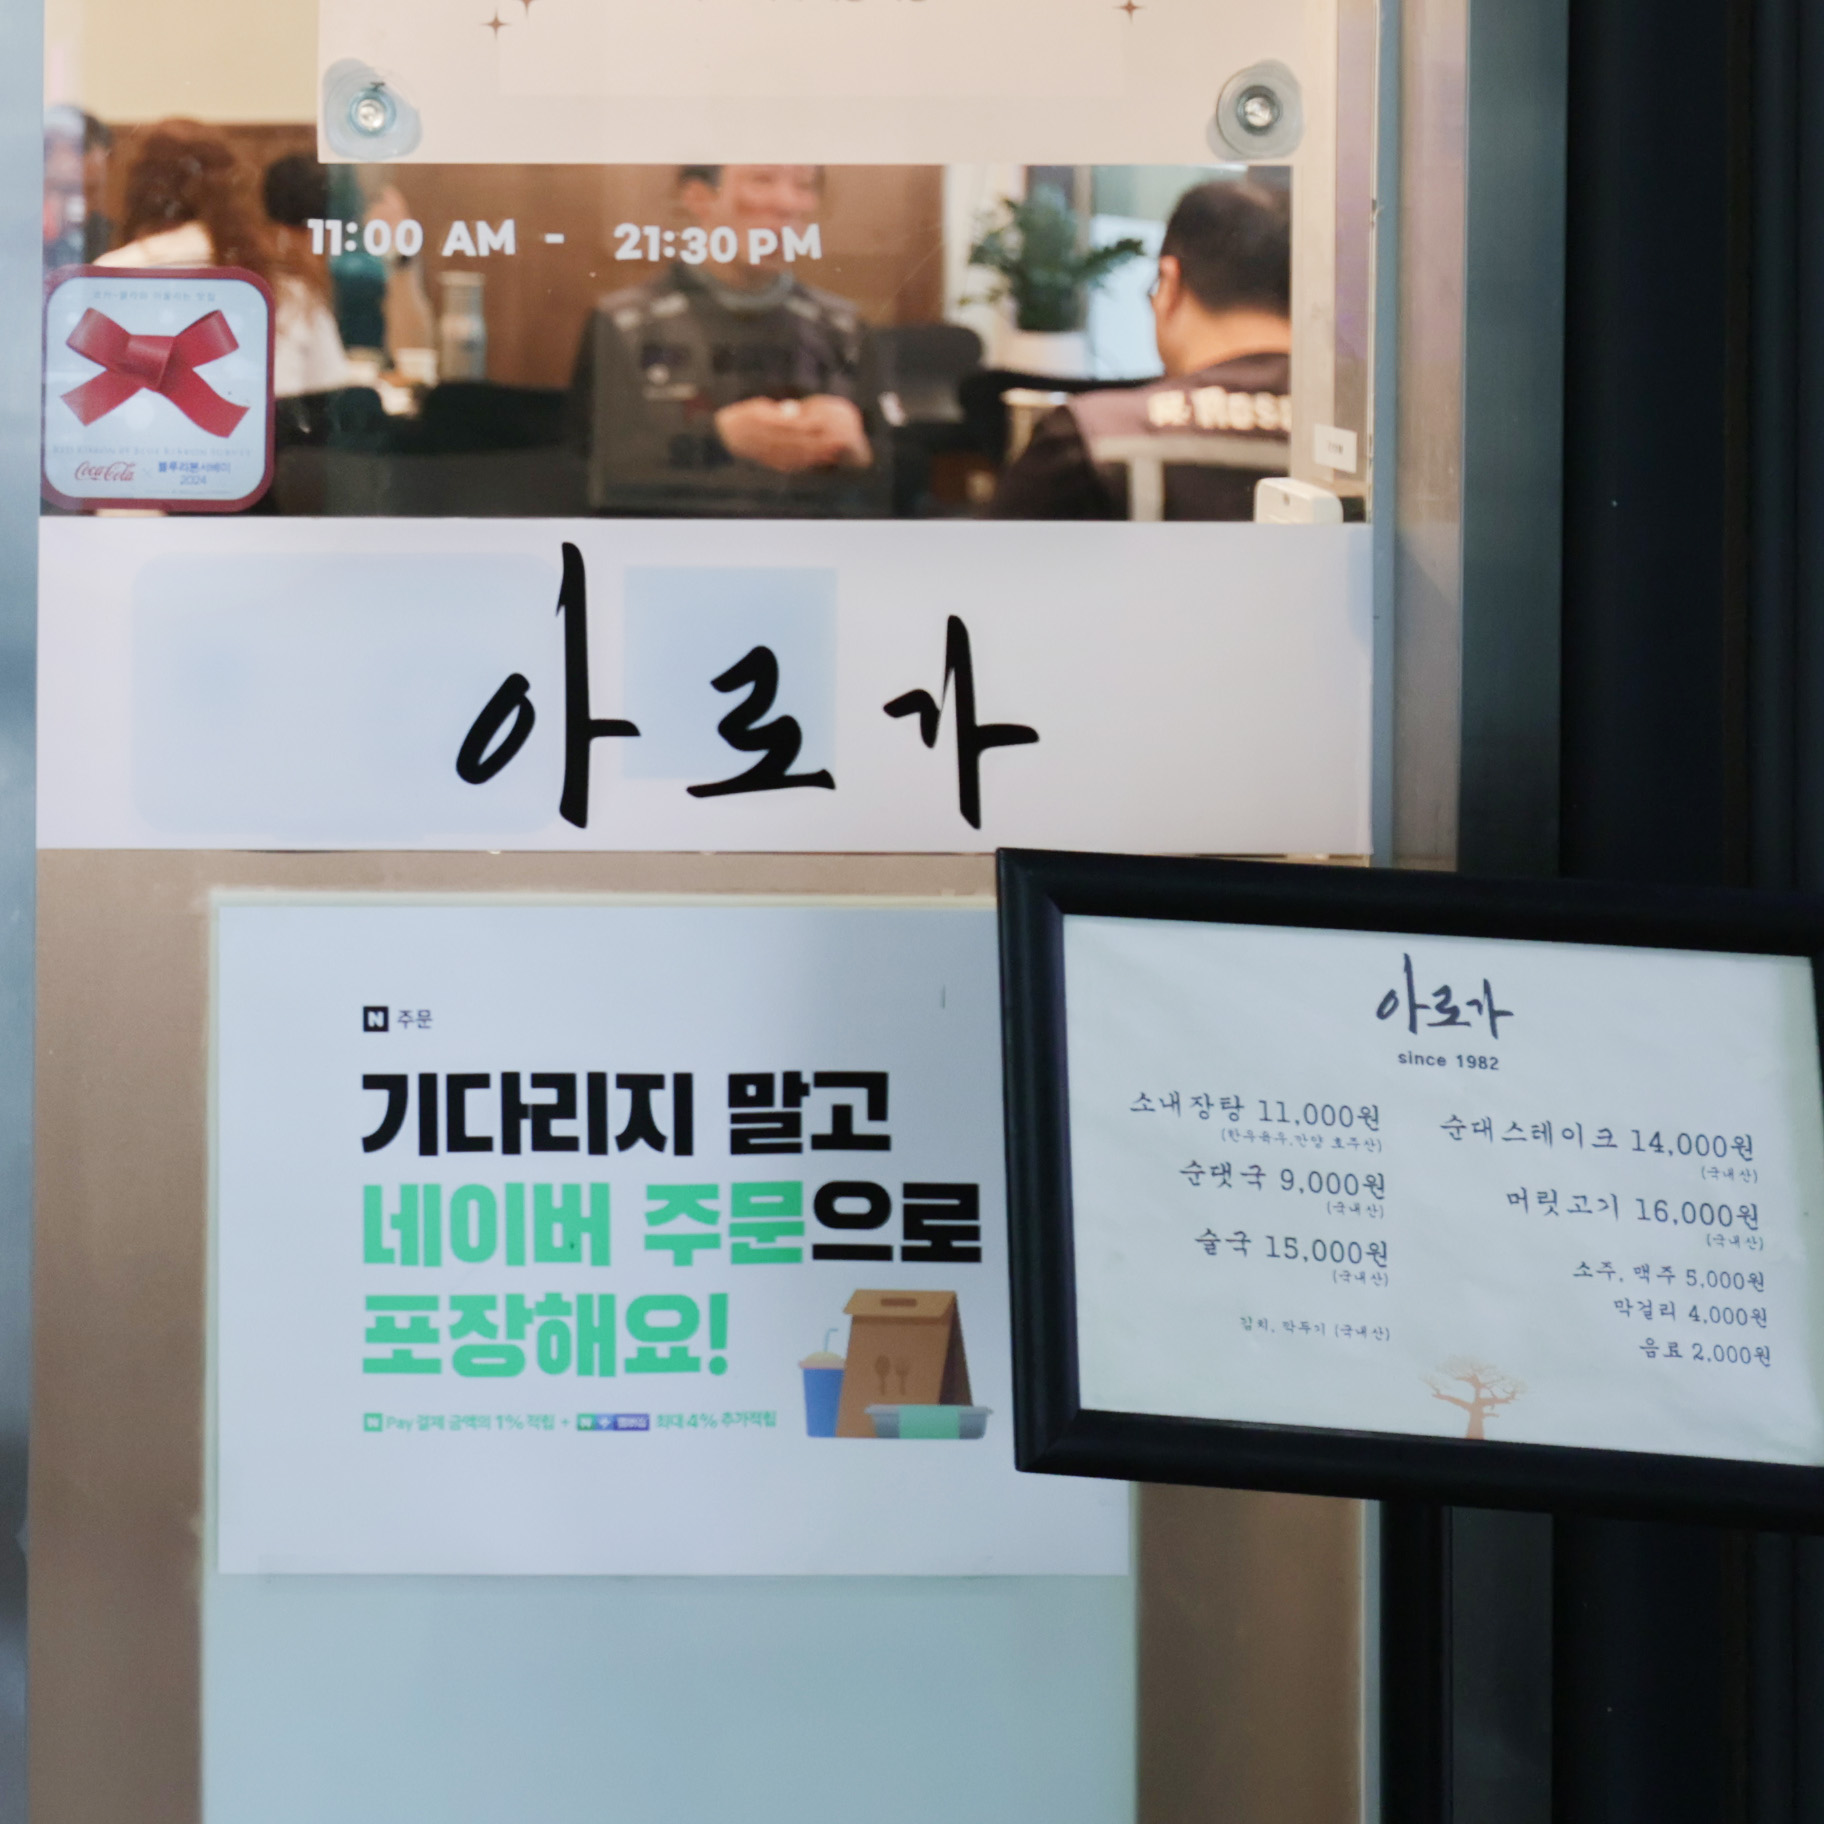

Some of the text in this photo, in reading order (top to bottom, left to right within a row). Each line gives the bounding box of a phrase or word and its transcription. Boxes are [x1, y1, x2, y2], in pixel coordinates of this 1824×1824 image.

[307, 218, 424, 256] 11:00
[442, 219, 517, 257] AM
[614, 222, 738, 265] 21:30
[748, 223, 823, 266] PM
[1376, 952, 1515, 1040] 아로가
[397, 1009, 434, 1030] 주문
[1398, 1051, 1500, 1071] since 1982
[361, 1071, 892, 1157] 기다리지 말고
[1258, 1100, 1380, 1132] 11,000원
[1632, 1129, 1754, 1162] 14,000원
[1179, 1160, 1386, 1201] 순댓국 9,000원
[362, 1180, 984, 1267] 네이버 주문으로
[1506, 1187, 1759, 1230] 머릿고기 16,000원
[1194, 1228, 1388, 1268] 술국 15,000원
[1633, 1262, 1677, 1286] 맥주
[1614, 1296, 1677, 1321] 막걸리
[362, 1292, 730, 1378] 포장해요!
[1639, 1337, 1683, 1360] 음료
